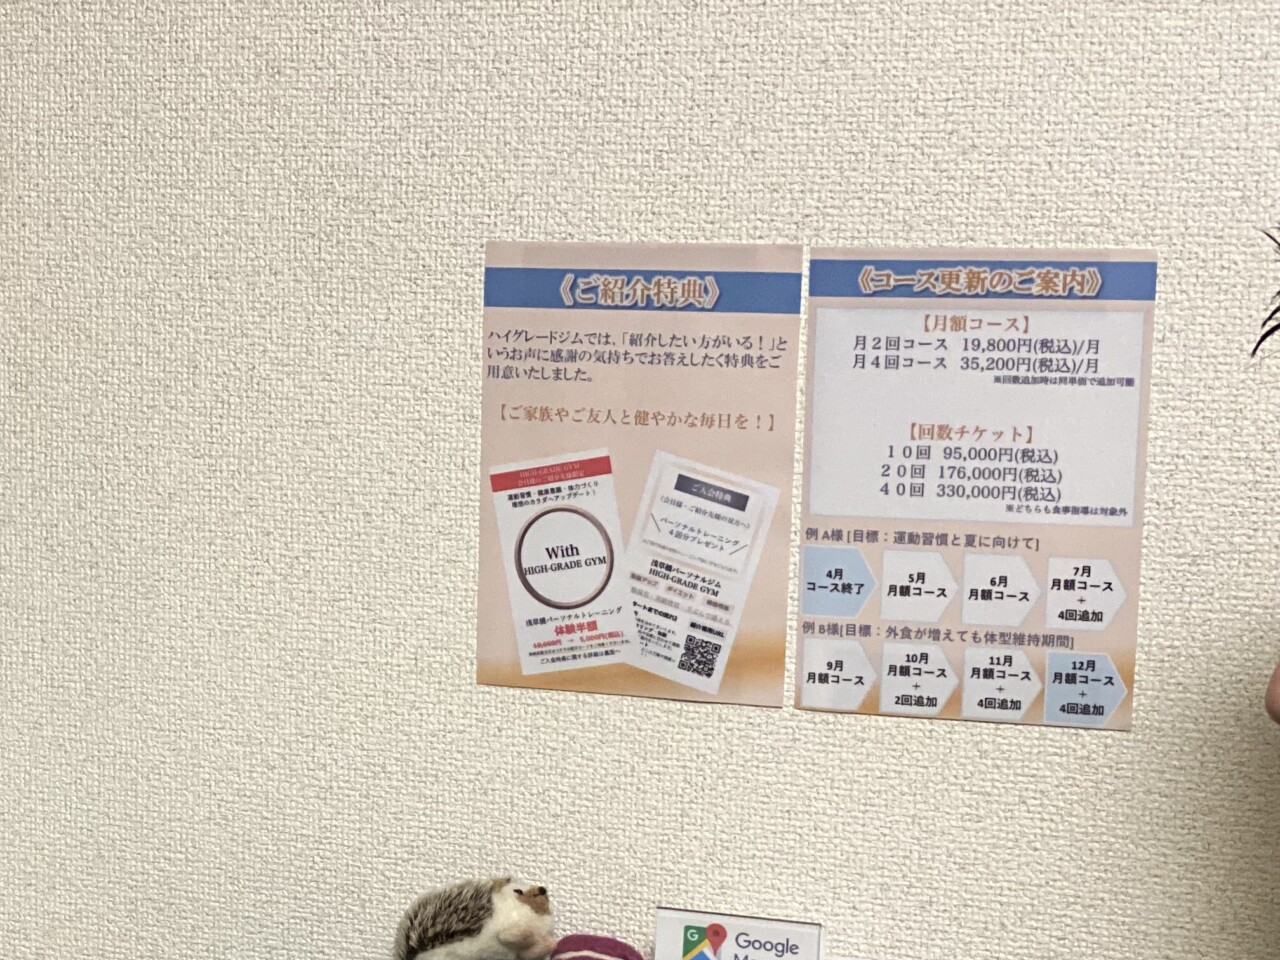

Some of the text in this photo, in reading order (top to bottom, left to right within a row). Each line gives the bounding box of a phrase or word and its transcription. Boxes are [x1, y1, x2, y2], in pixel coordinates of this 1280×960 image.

[858, 265, 1101, 297] 《コース更新のご案内》
[560, 273, 720, 309] 《ご紹介特典》
[923, 314, 1029, 333] 【月額コース】
[962, 337, 1100, 355] 19,800円(税込)/月
[960, 356, 1099, 374] 35,200円(税込)/月
[487, 365, 593, 382] 用意いたしました。
[910, 422, 1033, 444] 【回数チケット】
[943, 446, 1058, 464] 95,000円(税込)
[938, 465, 1062, 484] 176,000円(税込)
[937, 484, 1062, 503] 330,000円(税込)
[660, 517, 740, 546] パーソナルトレーニング
[545, 544, 580, 560] With
[524, 556, 607, 576] HIGH-GRADE GYM
[1073, 565, 1091, 578] 7月
[826, 568, 843, 580] 4月
[908, 572, 926, 584] 5月
[649, 568, 698, 590] HIGH-GRADE
[700, 582, 720, 597] GYM
[807, 581, 865, 596] コース終了
[989, 575, 1008, 588] 6月
[1050, 579, 1114, 592] 月額コース
[887, 585, 948, 598] 月額コース
[968, 588, 1030, 602] 月額コース
[1058, 609, 1104, 623] 4回追加
[554, 620, 598, 636] 体験半額
[905, 652, 929, 665] 10月
[989, 655, 1013, 667] 11月
[826, 660, 844, 672] 9月
[887, 665, 947, 678] 月額コース
[1071, 660, 1096, 672] 12月
[806, 672, 865, 686] 月額コース
[970, 667, 1032, 681] 月額コース
[1052, 672, 1115, 686] 月額コース
[894, 694, 938, 708] 2回追加
[977, 697, 1022, 711] 4回追加
[1059, 703, 1105, 716] 4回追加
[735, 932, 799, 958] Google
